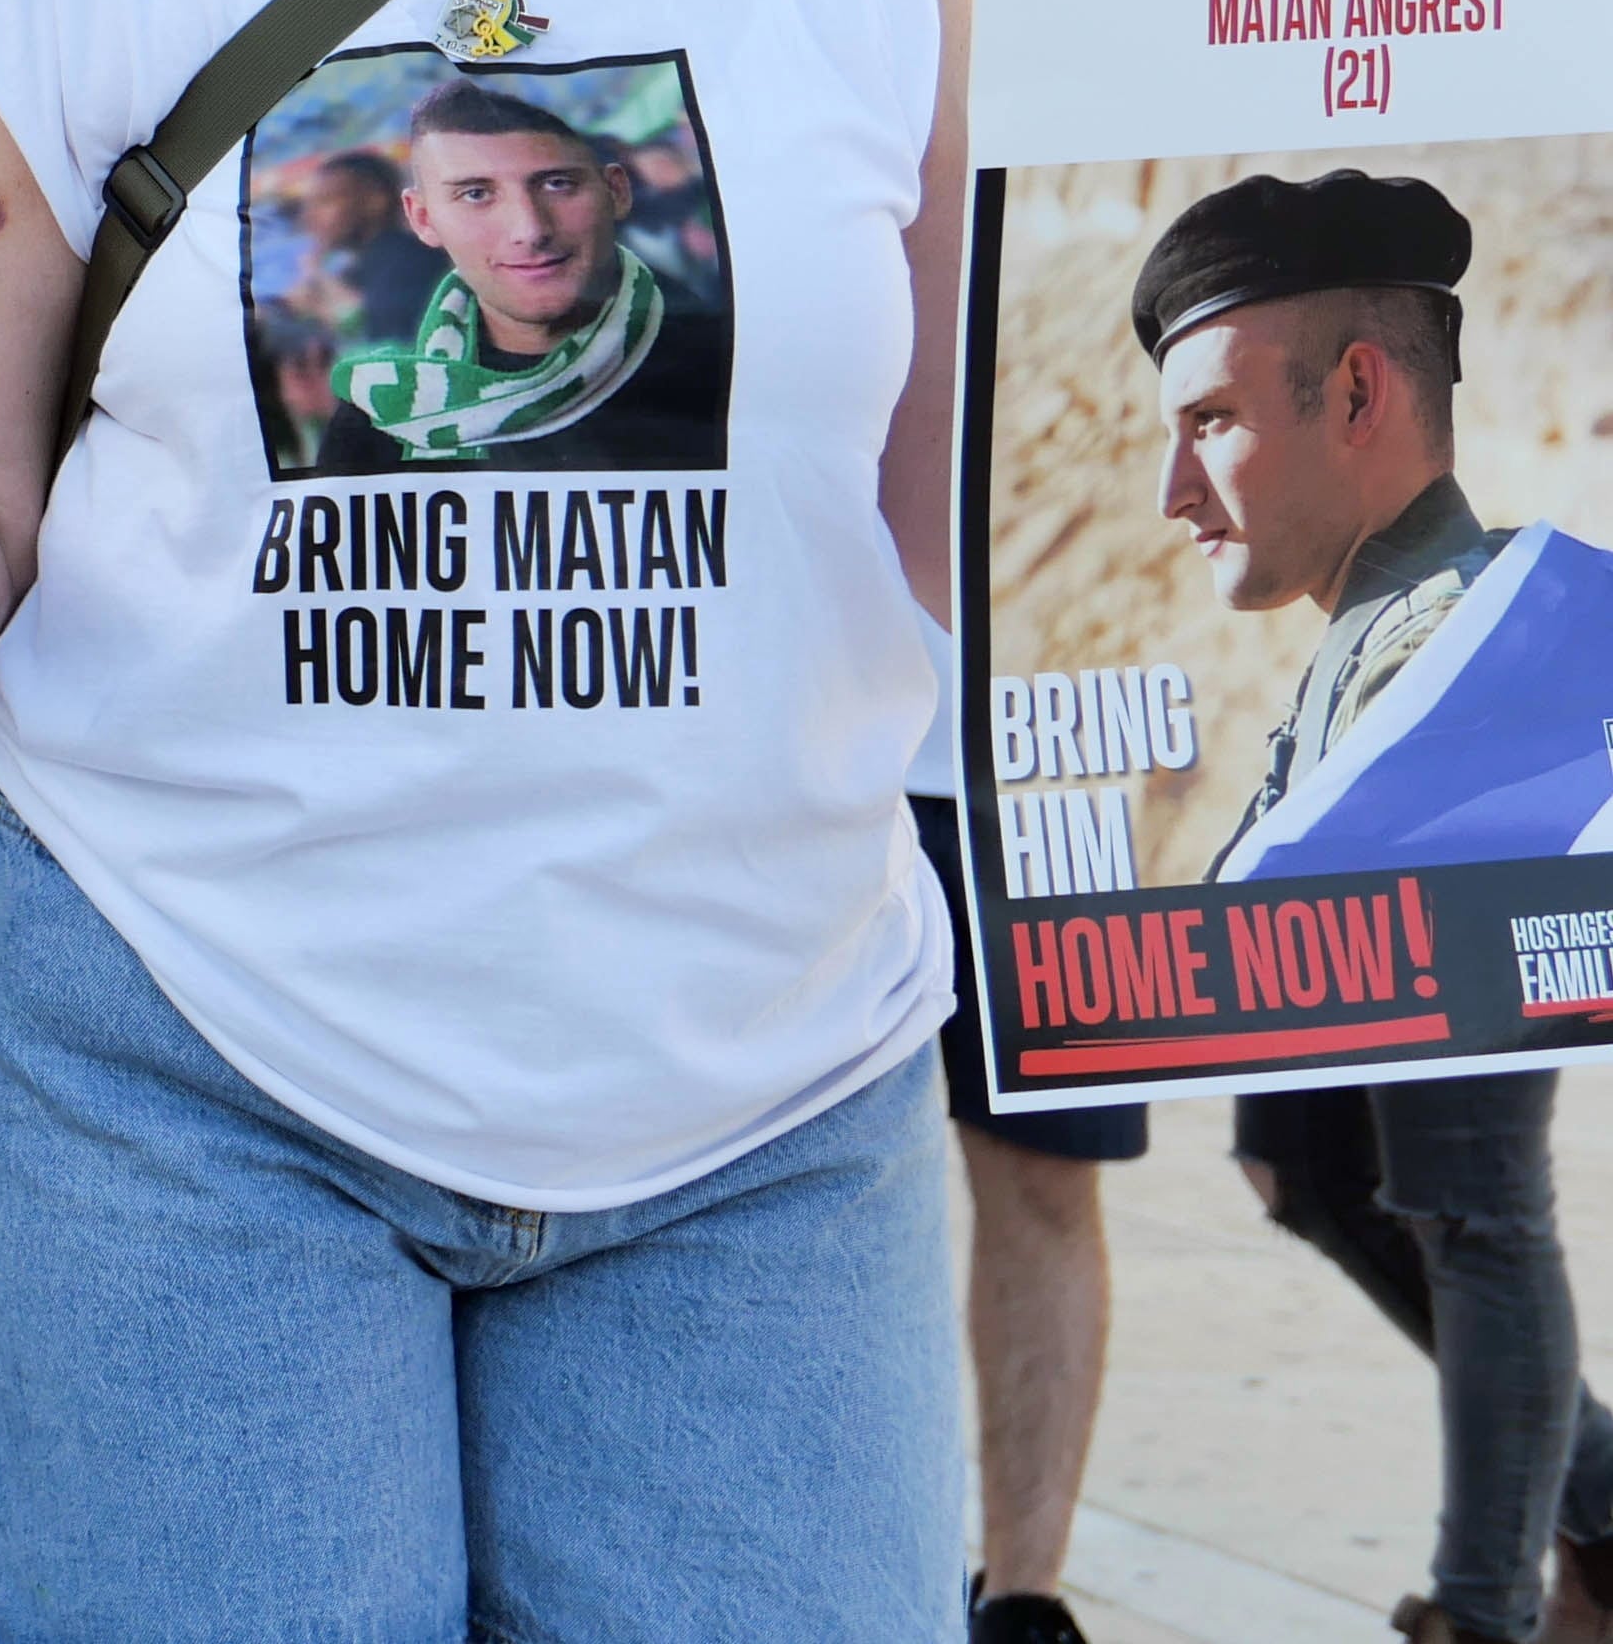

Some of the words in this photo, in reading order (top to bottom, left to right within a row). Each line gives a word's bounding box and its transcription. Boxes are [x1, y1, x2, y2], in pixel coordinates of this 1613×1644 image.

[435, 33, 471, 55] 7.10.2
[1323, 44, 1391, 117] (21)
[253, 488, 469, 594] BRING
[494, 488, 728, 591] MATAN
[284, 607, 487, 708] HOME
[513, 605, 700, 706] NOW!
[991, 661, 1194, 781] BRING
[998, 785, 1136, 899] HIM
[1011, 908, 1216, 1029] HOME
[1229, 877, 1439, 1012] NOW!
[1517, 948, 1613, 1004] FAMIL
